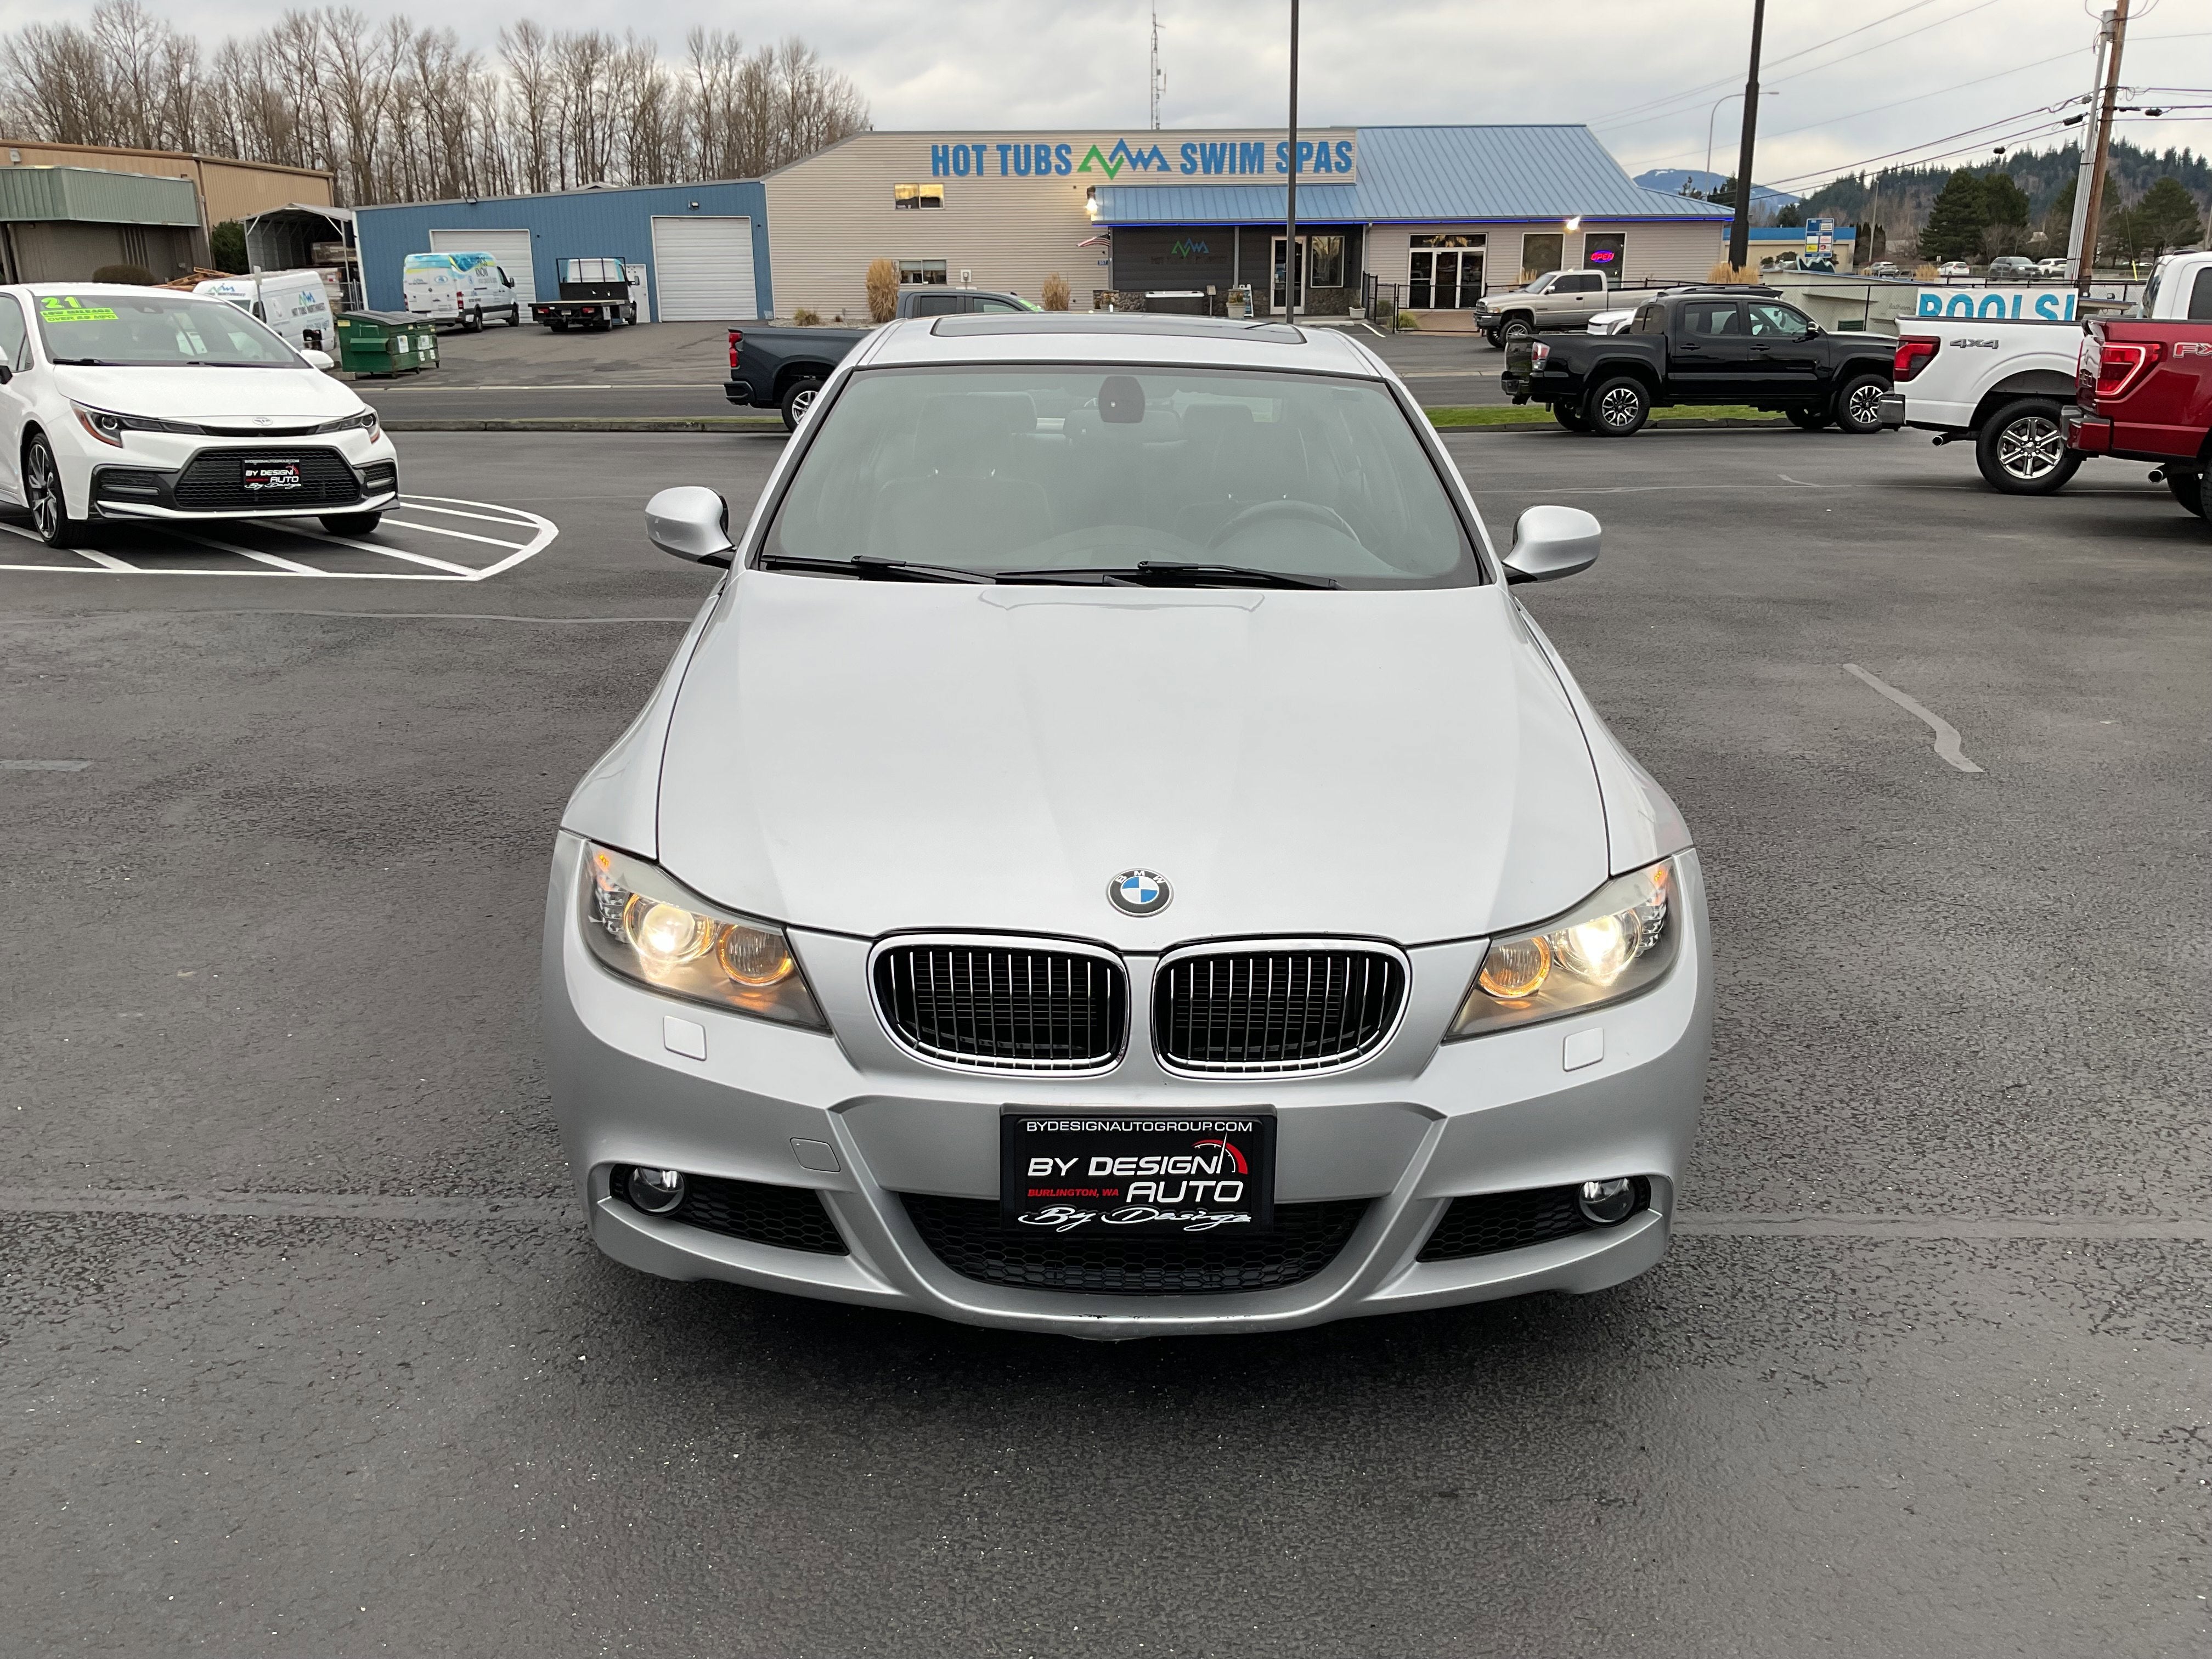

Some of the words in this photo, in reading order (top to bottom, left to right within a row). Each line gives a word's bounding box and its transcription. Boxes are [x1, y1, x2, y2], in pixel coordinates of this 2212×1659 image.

[932, 144, 986, 177] HOT
[996, 144, 1072, 176] TUBS
[1180, 143, 1265, 174] SWIM
[1276, 141, 1352, 173] SPAS
[1591, 252, 1615, 261] OPEN
[41, 296, 81, 308] 21
[1115, 870, 1165, 883] BMW
[1026, 1121, 1252, 1132] BYDESIGNAUTOGROUP.COM
[1028, 1157, 1079, 1176] BY
[1088, 1156, 1217, 1176] DESIGN
[1028, 1189, 1099, 1198] BURLINGTON,
[1102, 1189, 1119, 1197] WA
[1126, 1181, 1243, 1203] AUTO
[1018, 1207, 1096, 1232] By
[1101, 1207, 1251, 1231] Design
